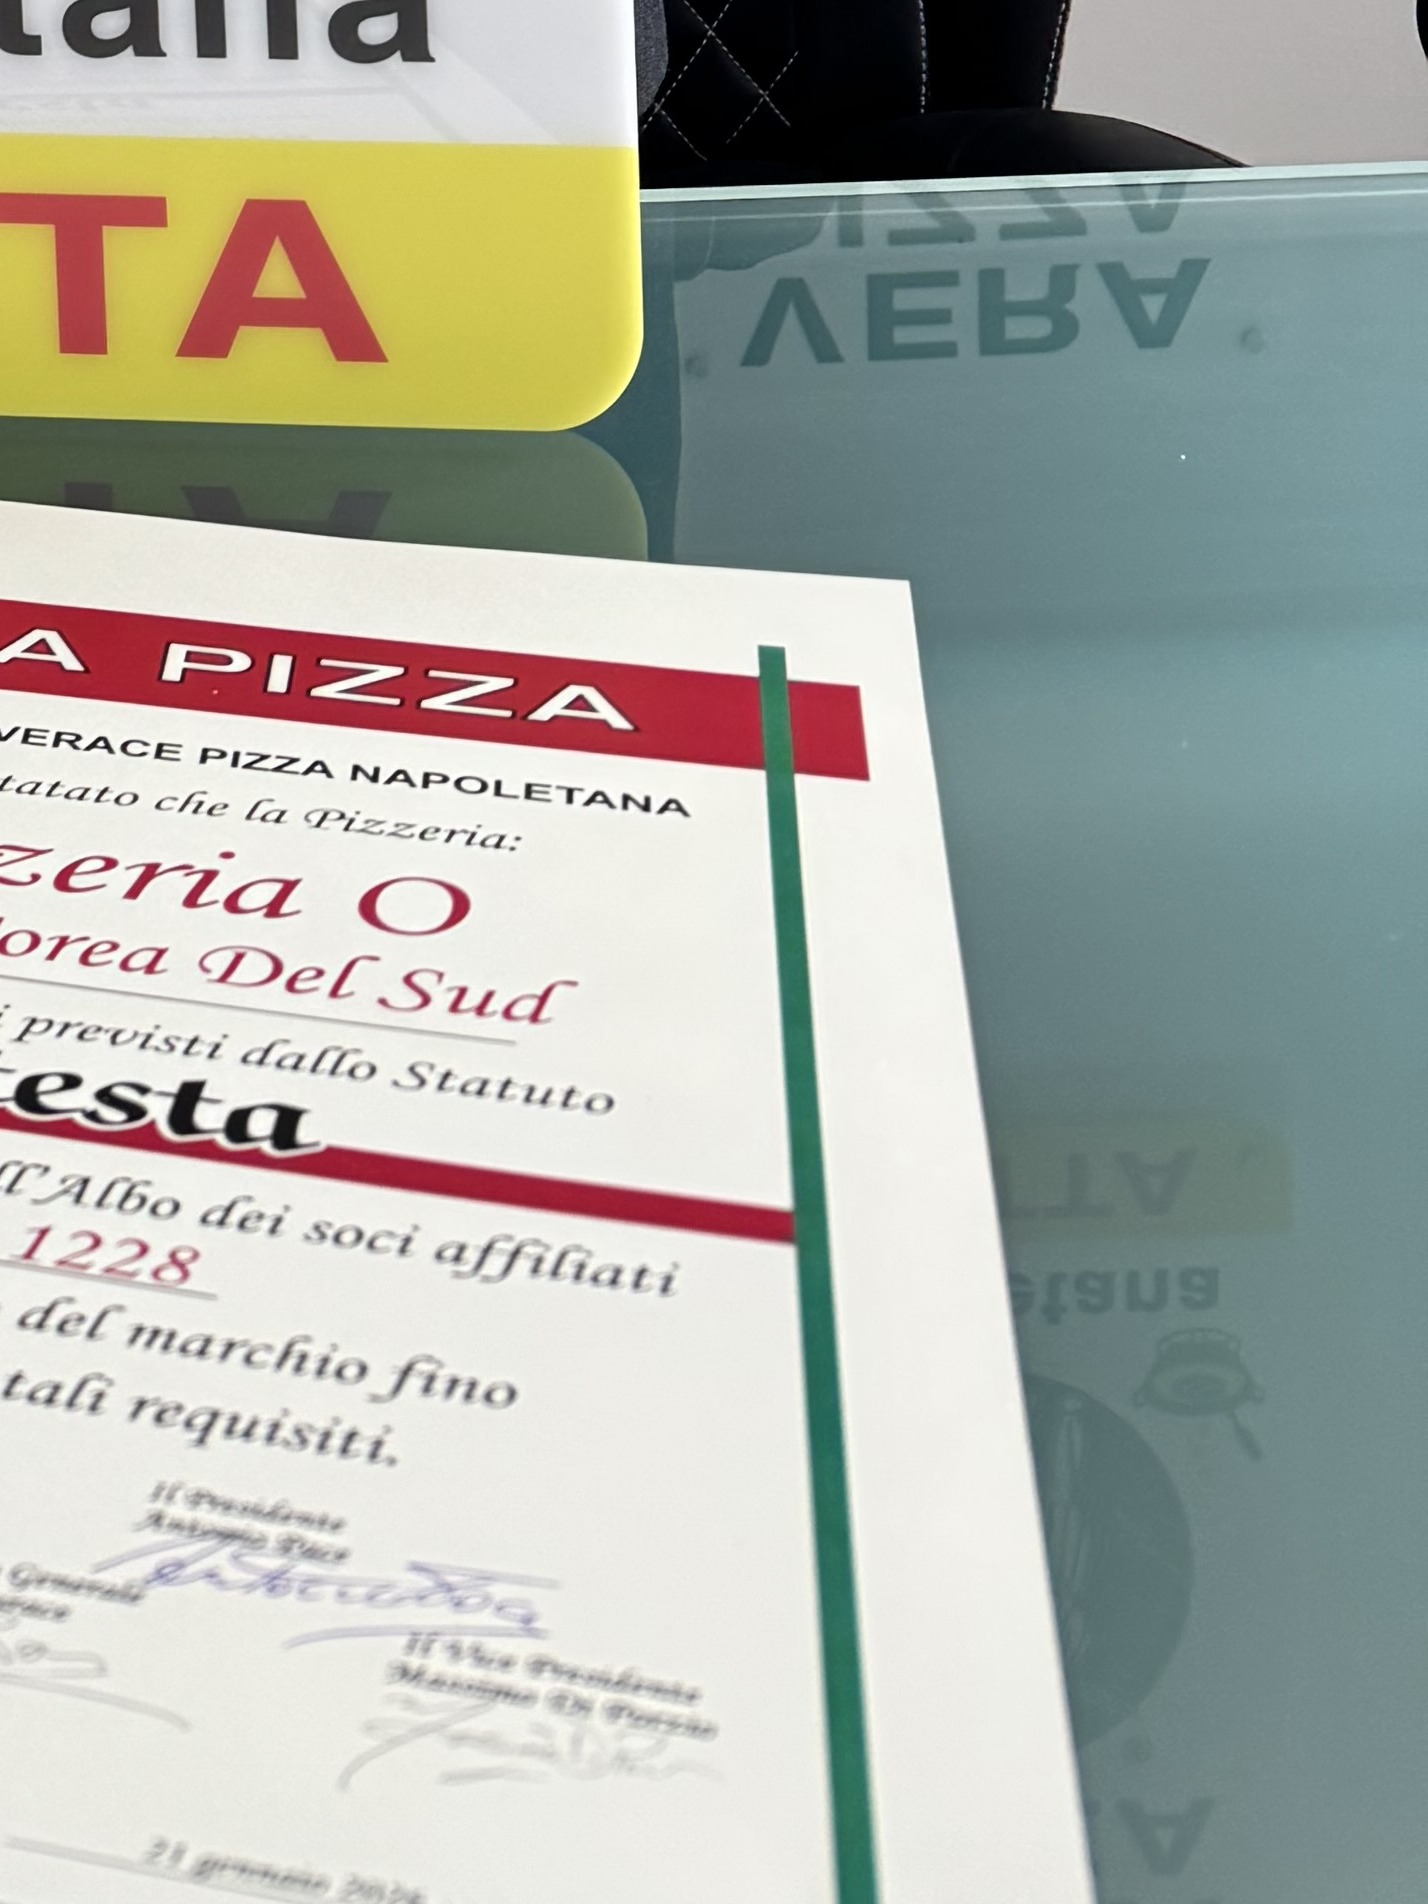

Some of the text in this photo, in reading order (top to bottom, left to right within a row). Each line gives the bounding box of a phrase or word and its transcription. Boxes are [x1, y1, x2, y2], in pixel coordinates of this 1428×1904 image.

[160, 642, 633, 730] PIZZA
[153, 789, 230, 818] che
[243, 797, 288, 825] la
[302, 807, 523, 852] Pizzeria:
[197, 745, 335, 780] PIZZA
[348, 762, 691, 818] NAPOLETANA
[356, 875, 472, 937] O
[196, 944, 381, 1000] Del
[375, 967, 578, 1025] Sud
[11, 1015, 229, 1061] previsti
[238, 1037, 378, 1081] dallo
[390, 1061, 615, 1113] Statuto
[4, 1224, 201, 1289] 1228
[198, 1194, 291, 1237] dei
[302, 1220, 420, 1257] soci
[432, 1233, 678, 1297] affiliati
[15, 1295, 125, 1341] del
[126, 1322, 369, 1384] marchio
[369, 1353, 519, 1407] fino
[0, 1369, 113, 1416] tali
[127, 1395, 397, 1467] requisiti.
